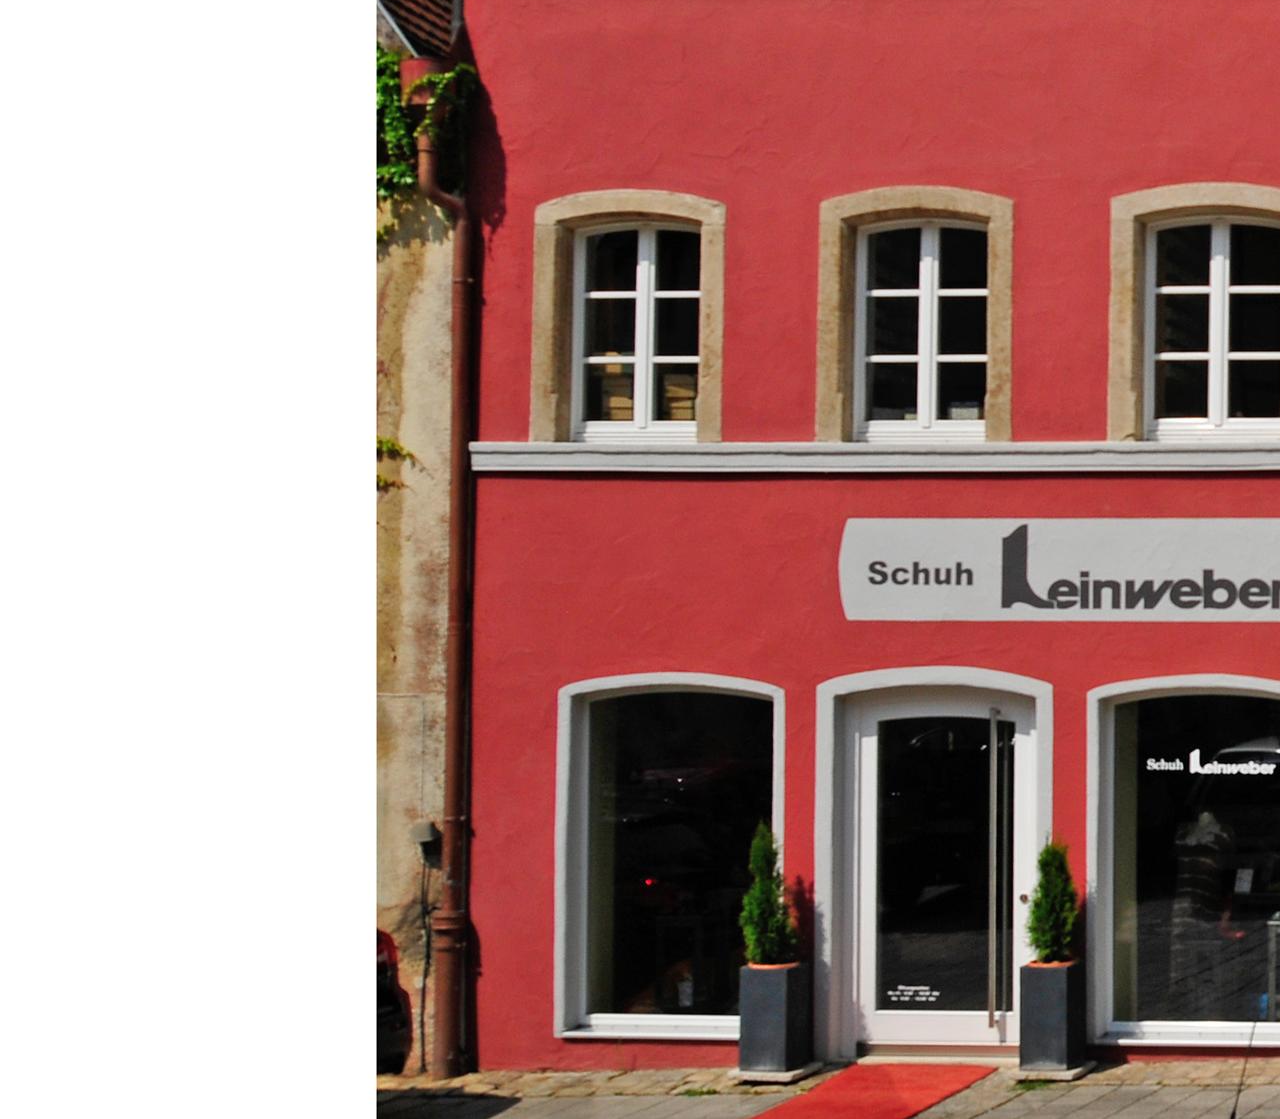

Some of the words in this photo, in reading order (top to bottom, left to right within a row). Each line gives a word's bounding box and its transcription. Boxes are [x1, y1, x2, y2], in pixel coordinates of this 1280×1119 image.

[867, 560, 974, 586] Schuh
[1146, 758, 1184, 771] Schuh
[1189, 748, 1277, 775] Leinweber
